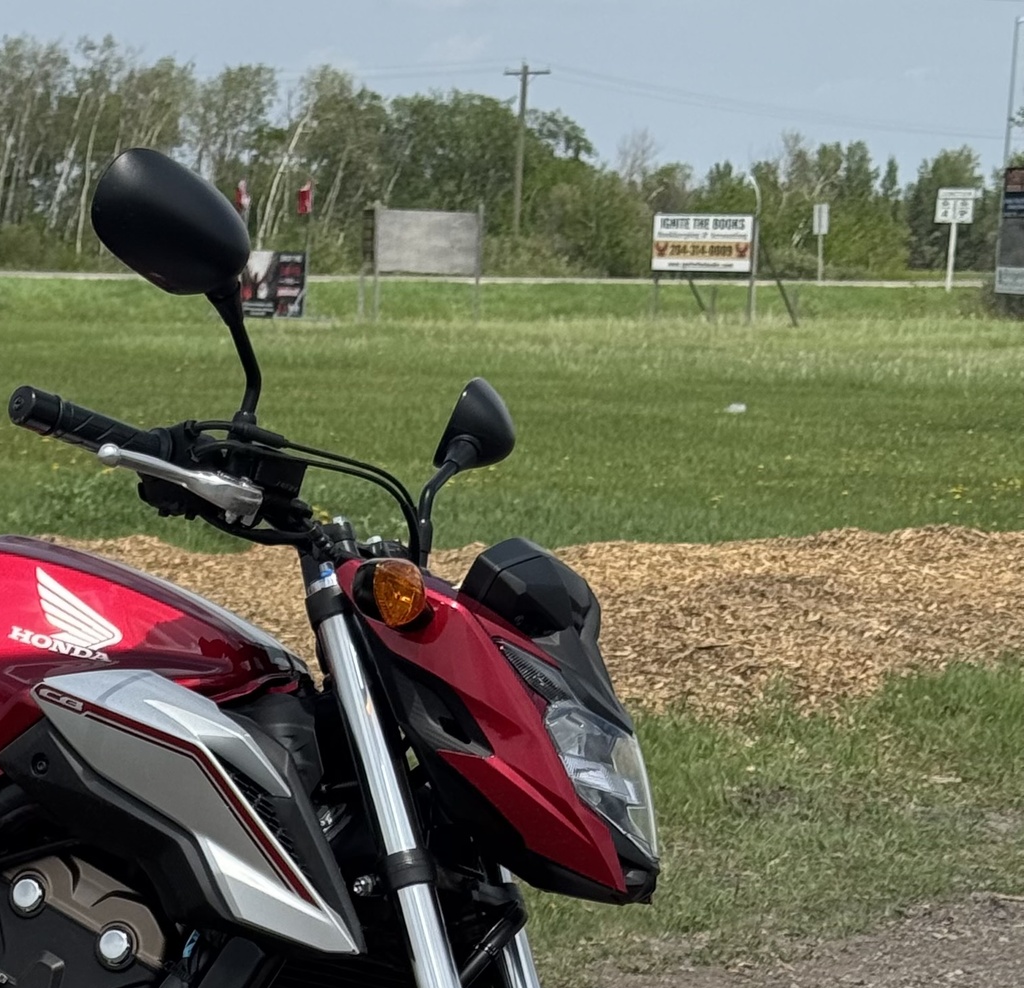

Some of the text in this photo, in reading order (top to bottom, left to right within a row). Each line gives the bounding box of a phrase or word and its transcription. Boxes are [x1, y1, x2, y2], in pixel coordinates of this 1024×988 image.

[660, 217, 746, 230] IGNITE THE BOOKS
[7, 624, 112, 663] HONDA
[39, 688, 85, 712] CB
